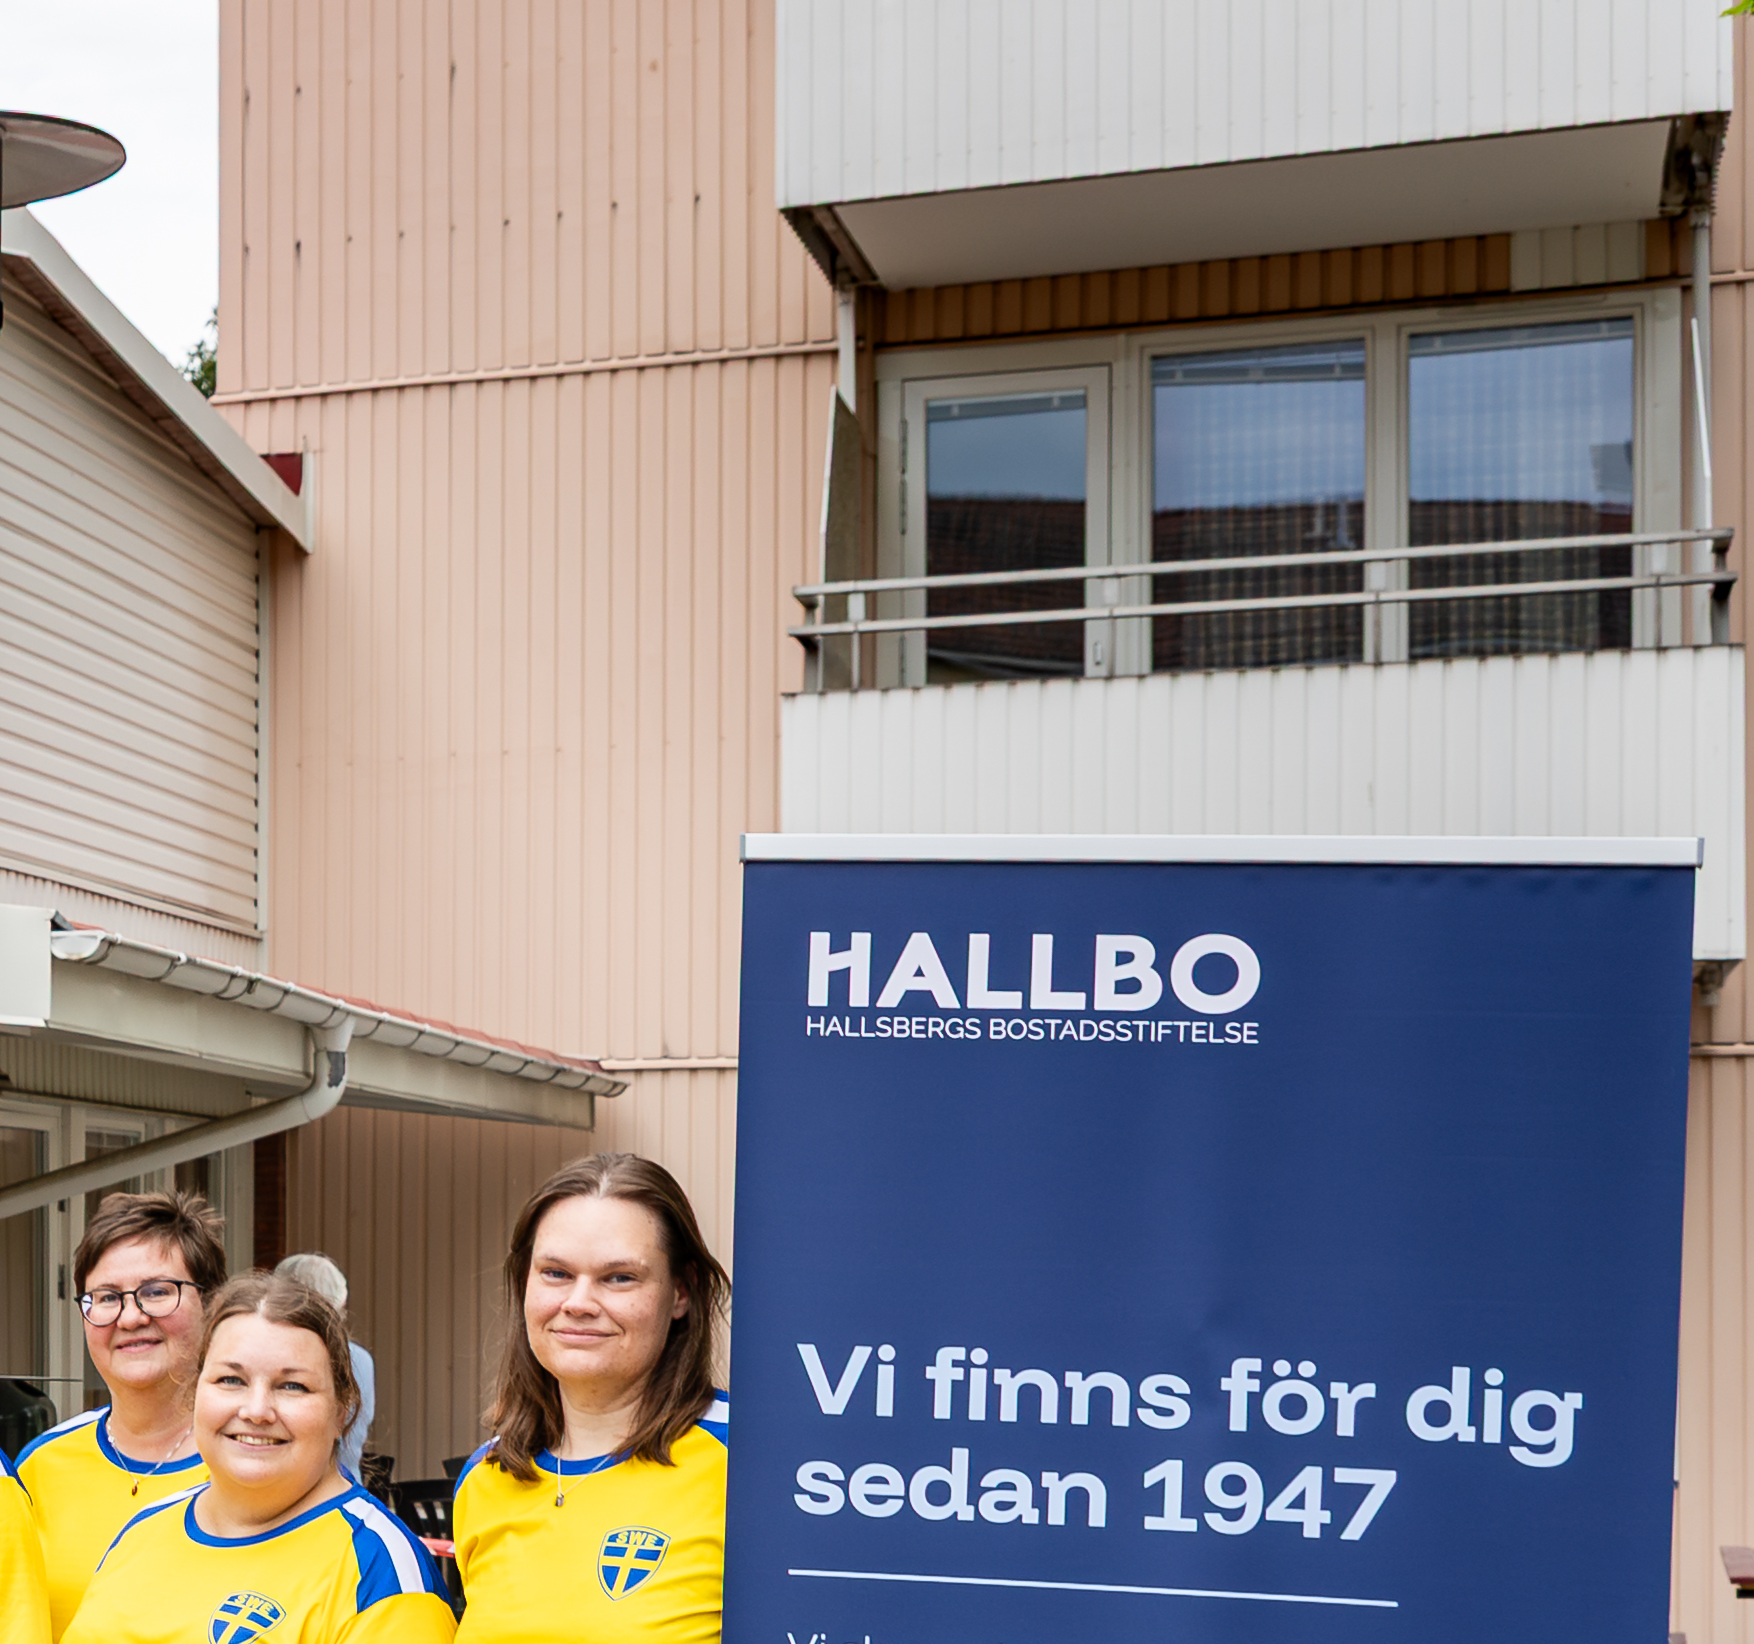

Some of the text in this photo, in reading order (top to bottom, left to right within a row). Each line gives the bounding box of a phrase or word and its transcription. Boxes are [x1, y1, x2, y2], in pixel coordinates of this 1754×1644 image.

[807, 931, 1261, 1015] HALLBO
[806, 1015, 1259, 1044] HALLSBERGS BOSTADSSTIFTELSE
[796, 1343, 1583, 1468] Vi finns för dig
[793, 1447, 1397, 1541] sedan 1947
[615, 1530, 659, 1547] SWE
[234, 1593, 275, 1616] SWE
